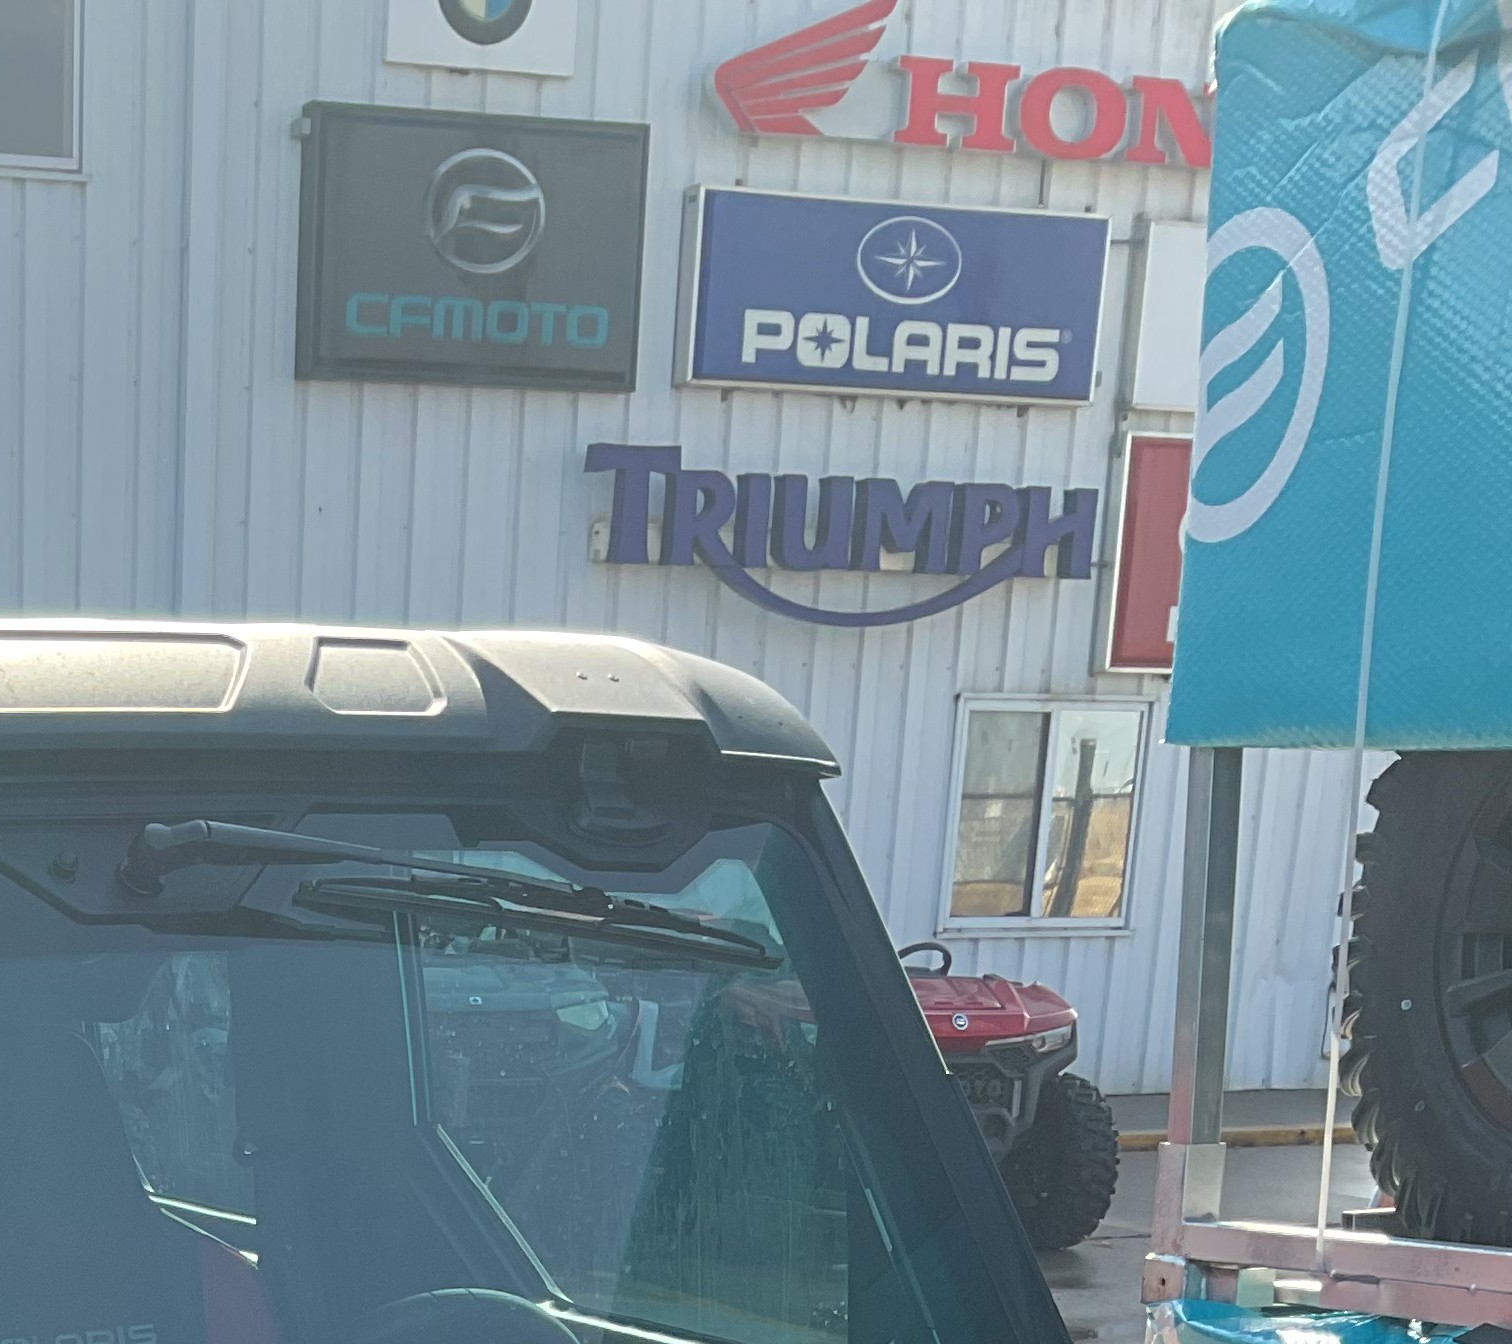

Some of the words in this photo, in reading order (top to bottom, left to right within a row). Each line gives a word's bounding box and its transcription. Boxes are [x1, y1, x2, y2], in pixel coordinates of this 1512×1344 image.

[346, 292, 609, 349] CFMOTO
[742, 308, 1061, 382] POLARIS
[583, 443, 1099, 627] TRIUMPH
